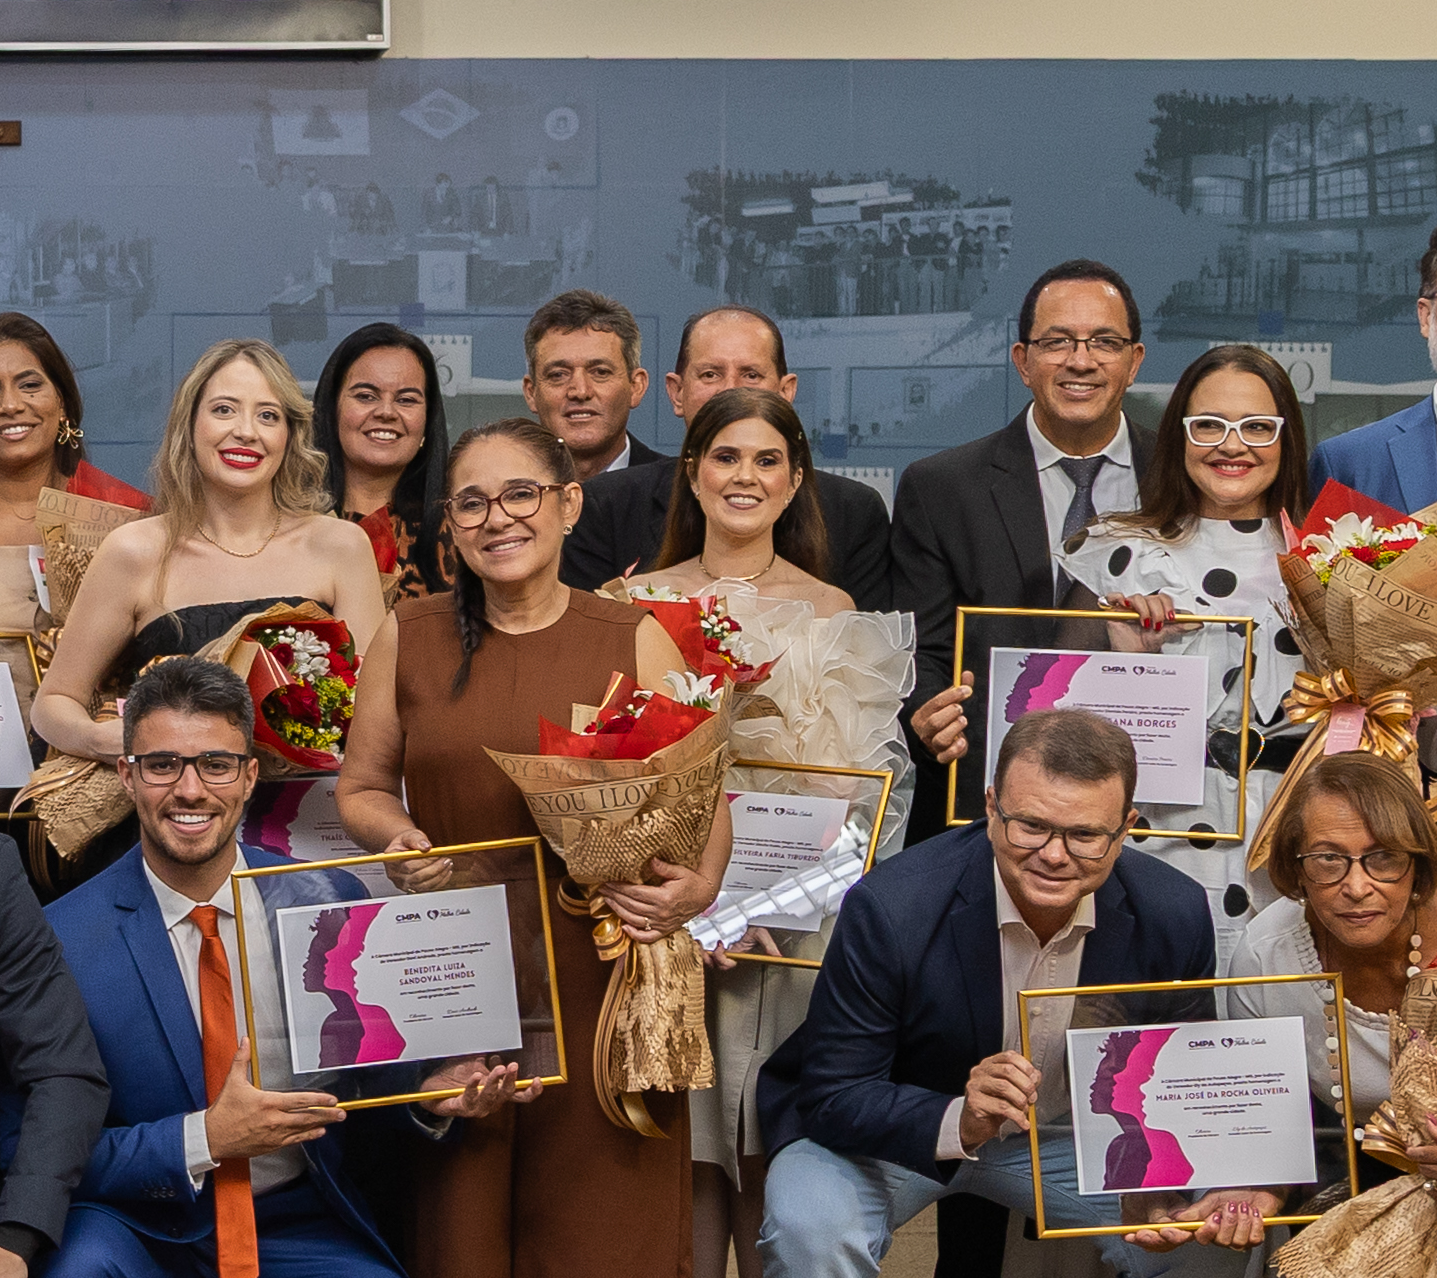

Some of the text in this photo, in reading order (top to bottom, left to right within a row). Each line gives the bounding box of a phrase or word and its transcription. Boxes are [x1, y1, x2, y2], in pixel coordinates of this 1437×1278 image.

[1333, 556, 1360, 582] OU
[1101, 665, 1126, 673] CMPA
[1137, 718, 1177, 728] BORGES
[543, 791, 586, 814] YOU
[746, 805, 769, 813] CMPA
[733, 849, 763, 857] SILVEIRA
[765, 851, 785, 859] FARIA
[395, 913, 421, 922] CMPA
[404, 962, 466, 976] BENEDITA LUIZA
[399, 970, 476, 986] SANDOVAL MENDES
[1188, 1039, 1215, 1049] CMPA
[1156, 1087, 1290, 1102] MARIA JOSÉ DA ROCHA OLIVEIRA
